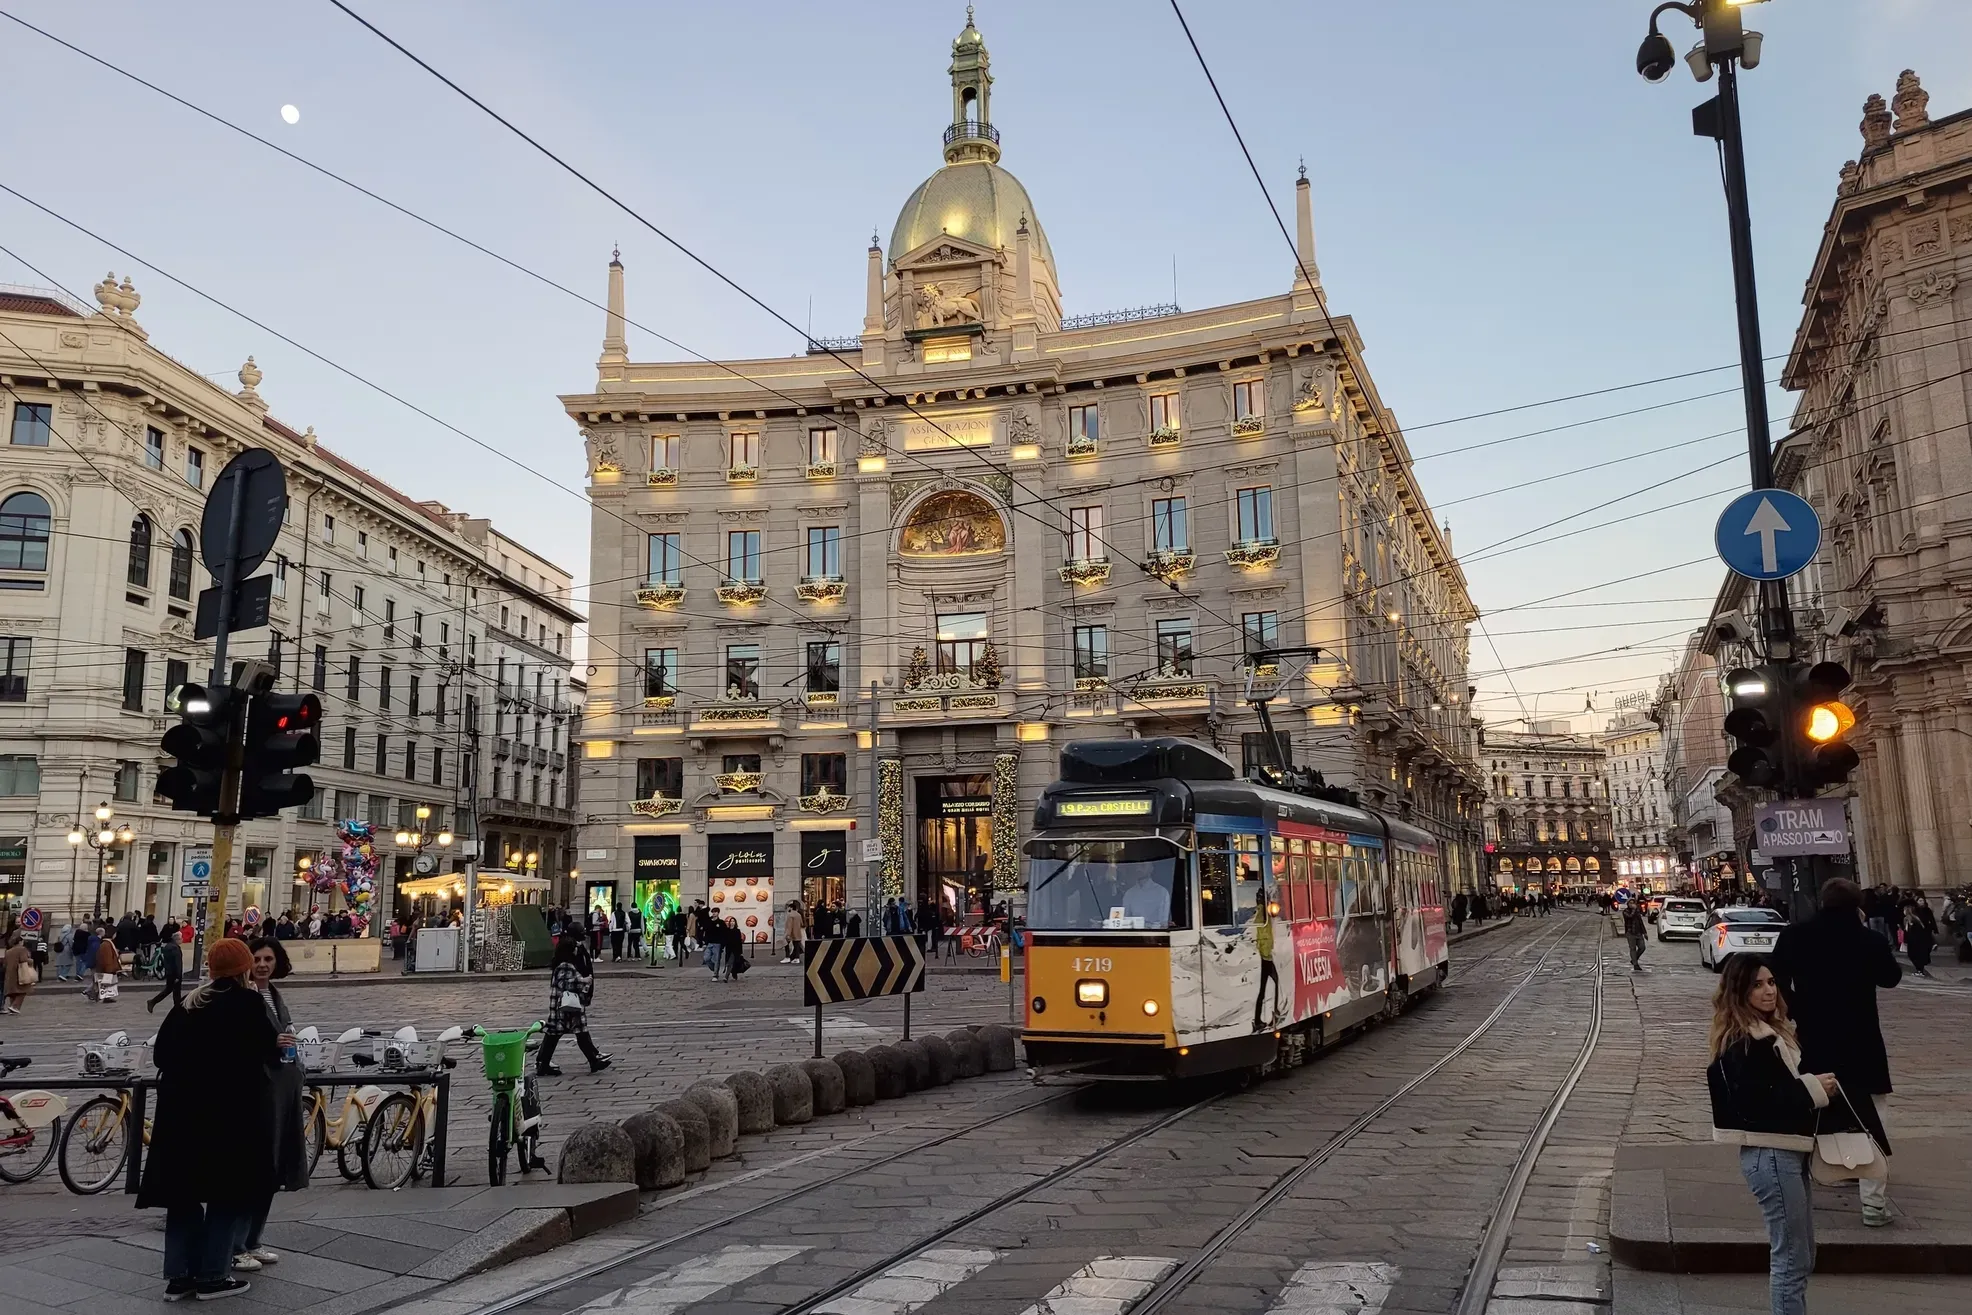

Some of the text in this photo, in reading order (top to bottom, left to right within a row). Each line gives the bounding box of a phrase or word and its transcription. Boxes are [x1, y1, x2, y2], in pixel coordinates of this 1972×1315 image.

[1061, 804, 1074, 813] 19
[1100, 801, 1149, 811] CASTELLI
[1775, 808, 1824, 830] TRAM
[1763, 833, 1771, 847] A
[1770, 831, 1803, 846] PASSO
[638, 858, 678, 867] SWAROVSKI
[1071, 957, 1112, 972] 4719
[1299, 951, 1333, 986] VALSESIA
